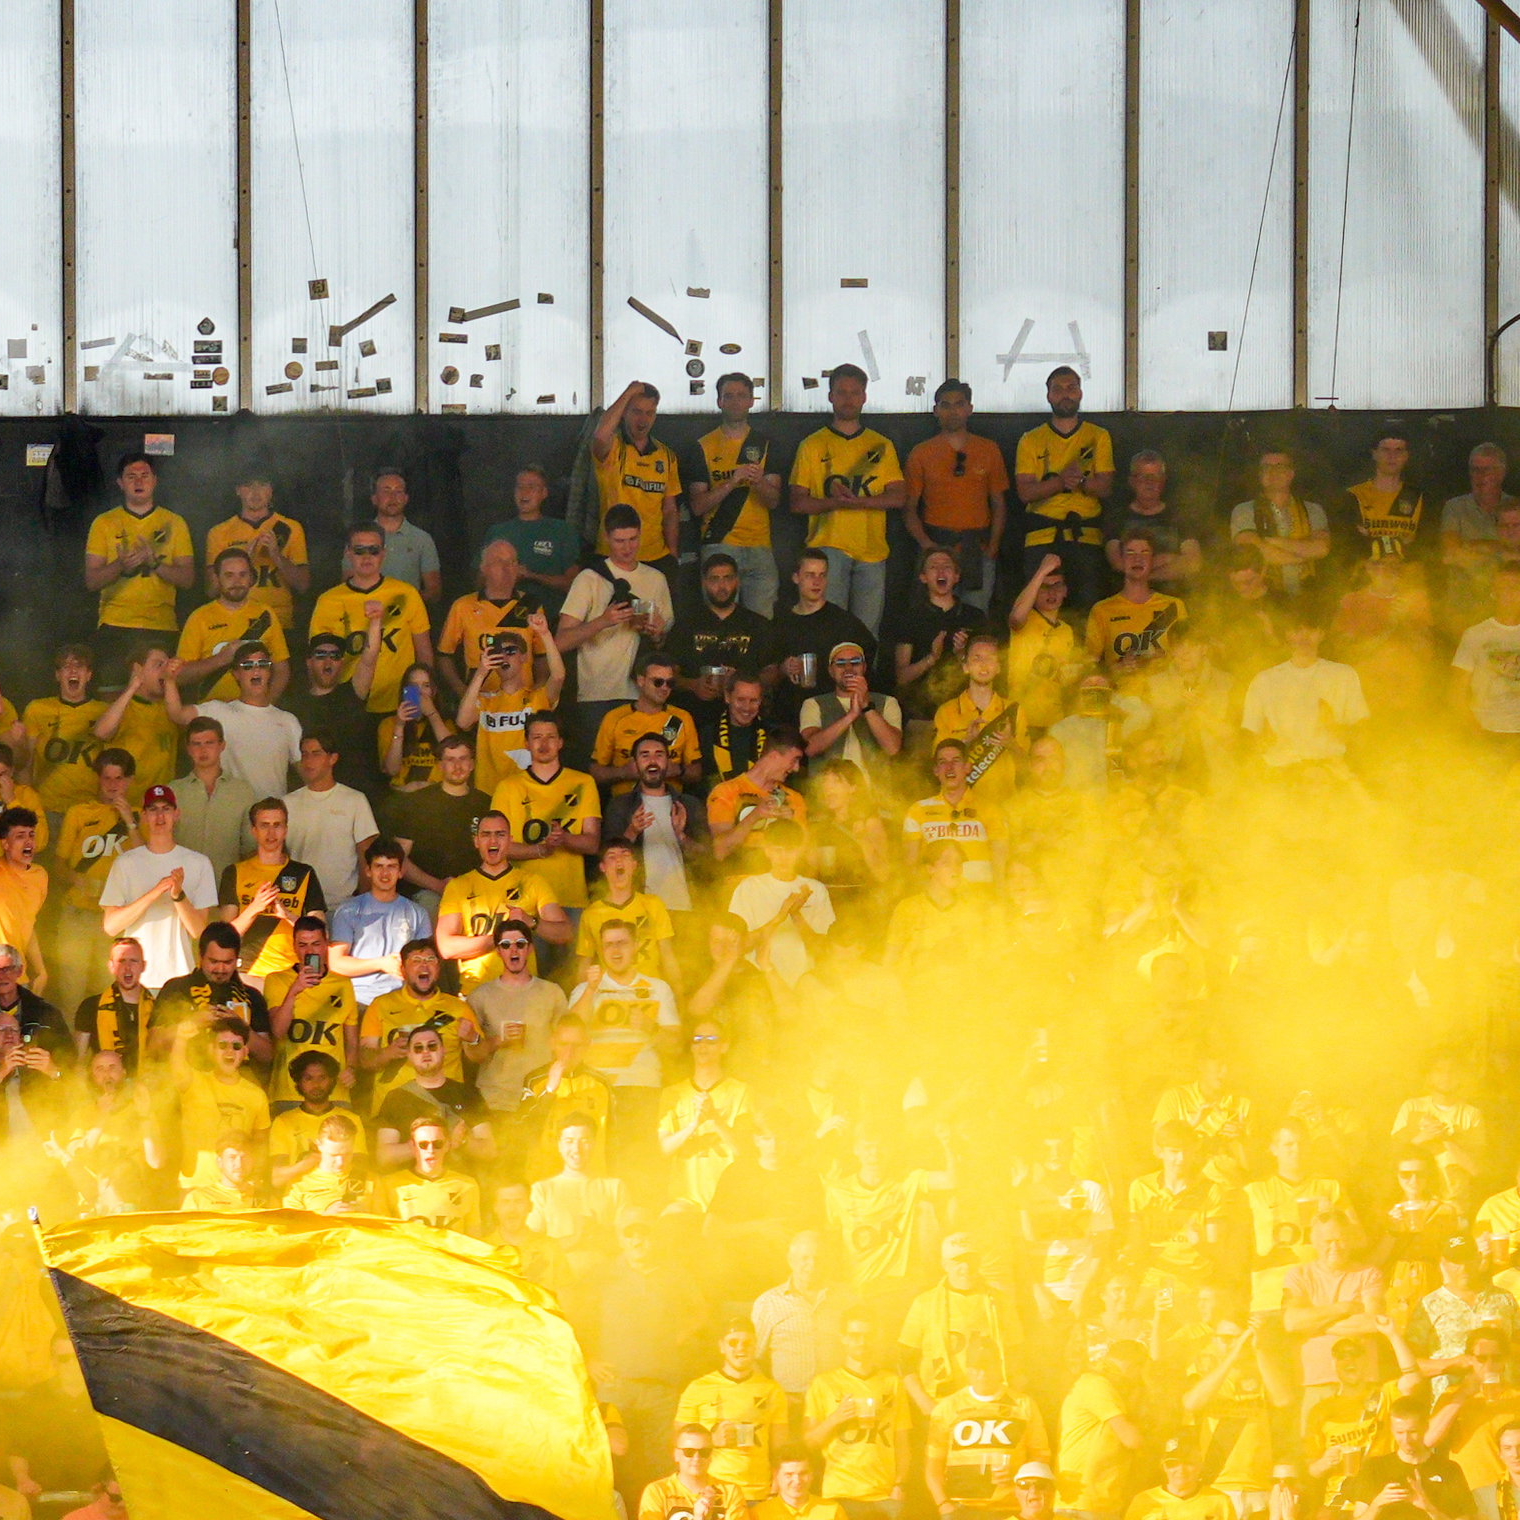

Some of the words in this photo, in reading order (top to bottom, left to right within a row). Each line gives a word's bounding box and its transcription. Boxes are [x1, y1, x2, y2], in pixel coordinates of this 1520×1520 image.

[1113, 629, 1167, 659] OK
[82, 834, 129, 858] OK
[289, 1021, 339, 1045] OK
[953, 1420, 1011, 1445] OK
